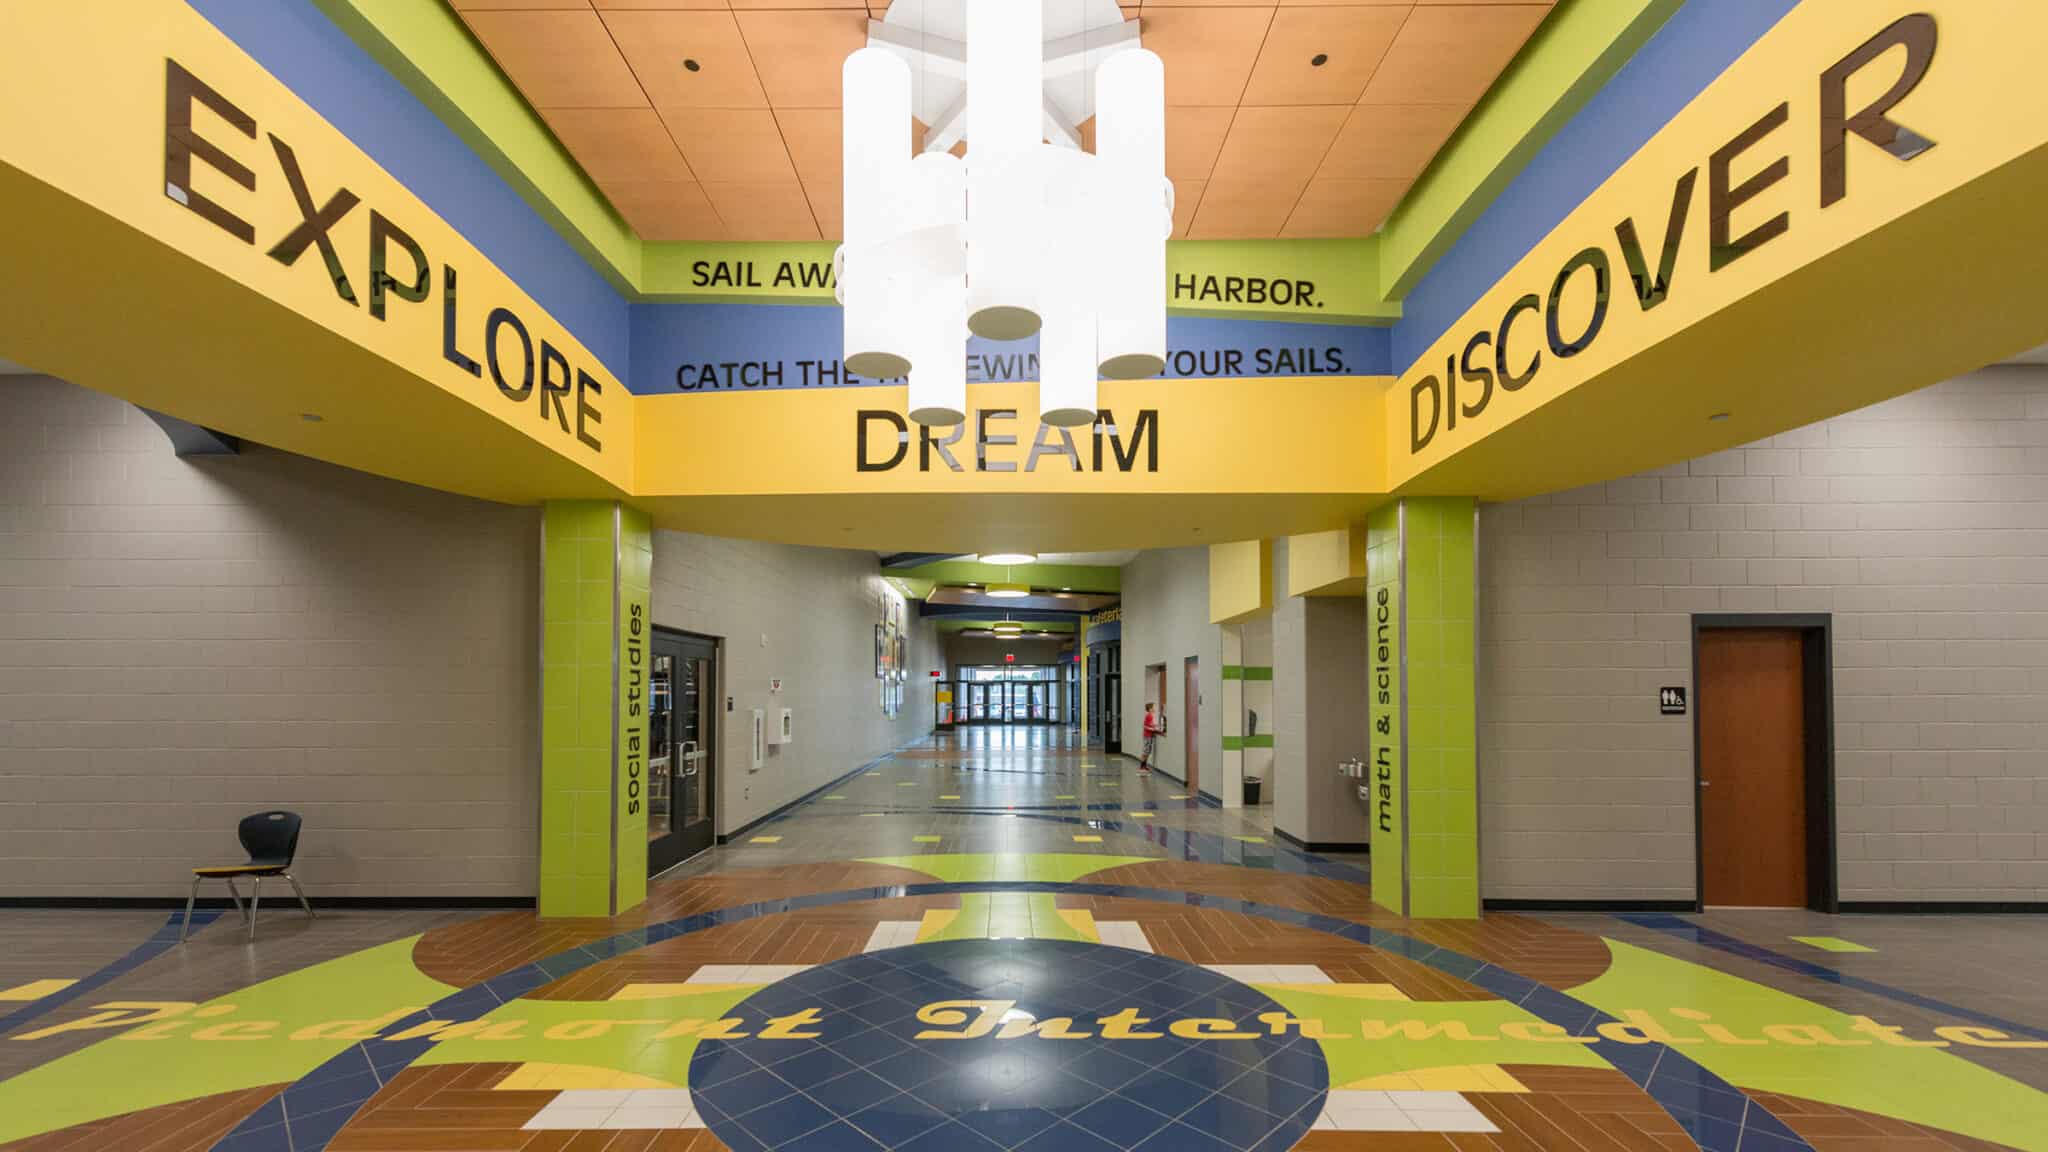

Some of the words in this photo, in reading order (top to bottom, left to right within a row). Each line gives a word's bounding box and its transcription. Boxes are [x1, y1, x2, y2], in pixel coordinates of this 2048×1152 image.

[165, 57, 602, 453] EXPLORE
[1411, 12, 1938, 455] DISCOVER
[691, 260, 761, 287] SAIL
[773, 261, 838, 288] AW
[1174, 273, 1324, 308] HARBOR.
[676, 360, 784, 390] CATCH
[1255, 347, 1352, 374] SAILS.
[856, 408, 1159, 472] DREAM
[627, 603, 642, 717] studies
[1376, 587, 1390, 705] science
[1376, 714, 1391, 735] &
[627, 728, 641, 815] social
[1376, 747, 1391, 833] math
[7, 1000, 823, 1041] Piedmont
[913, 998, 2048, 1049] Intermediate
